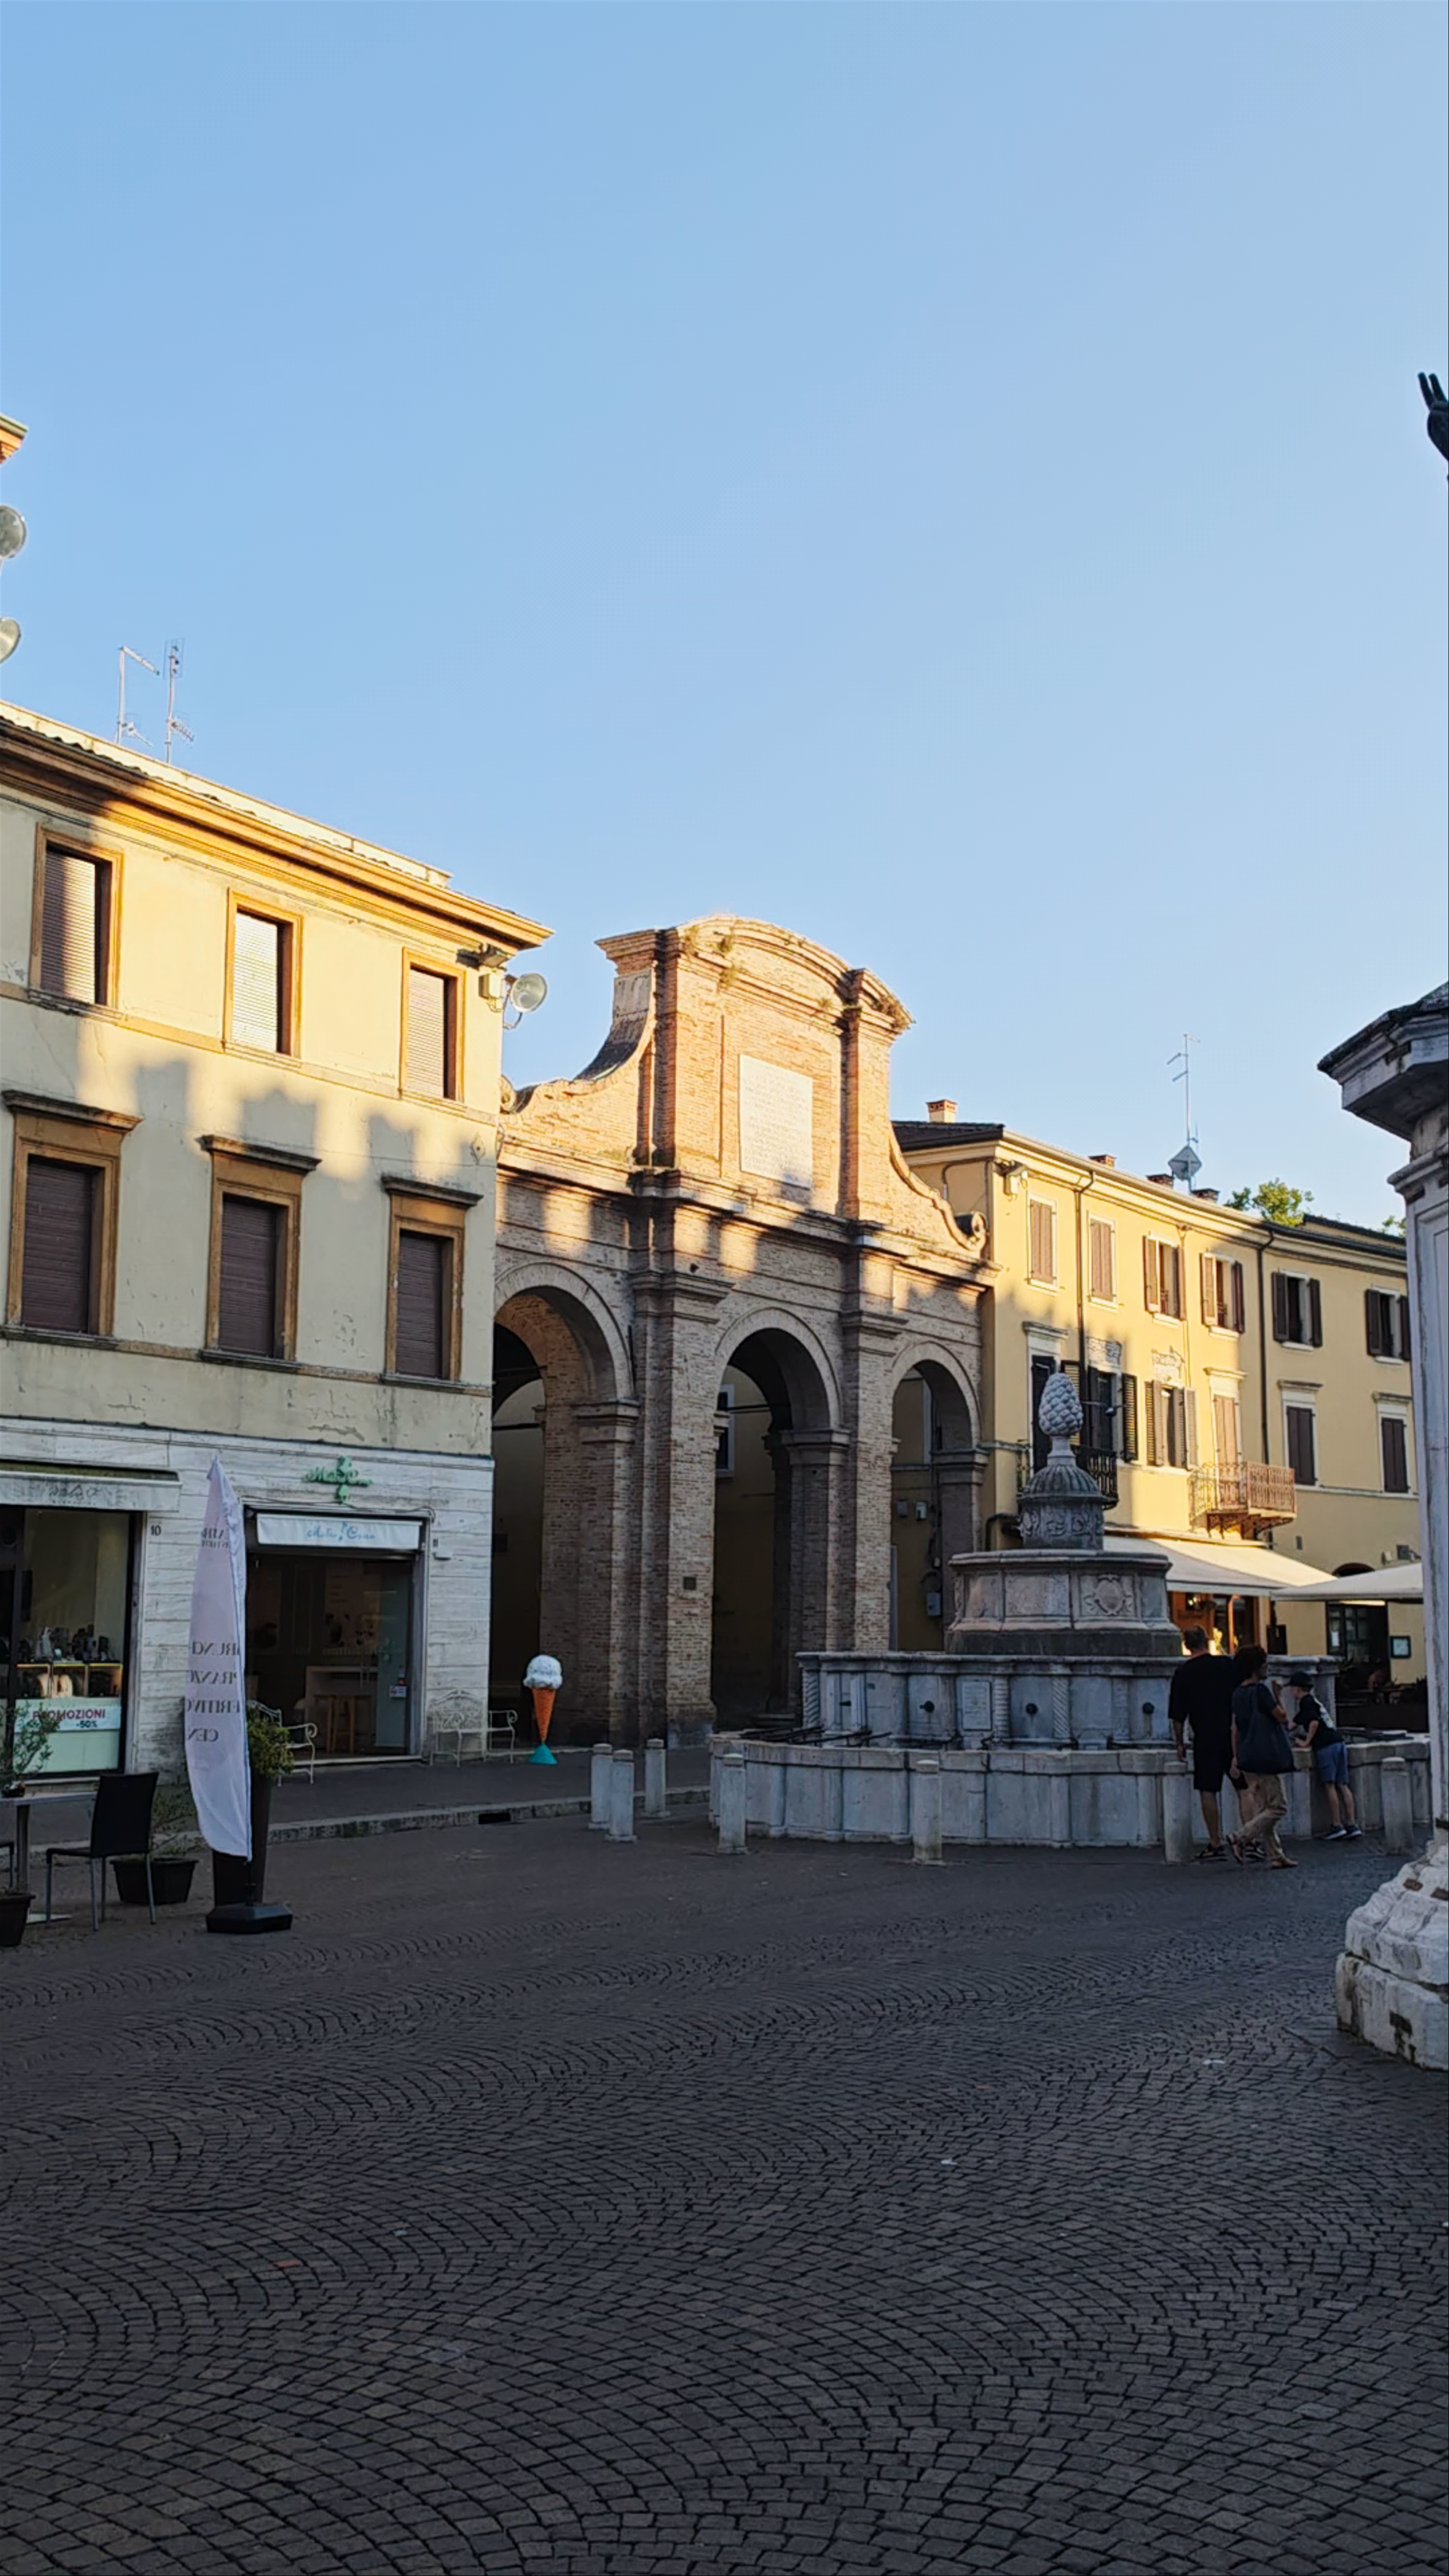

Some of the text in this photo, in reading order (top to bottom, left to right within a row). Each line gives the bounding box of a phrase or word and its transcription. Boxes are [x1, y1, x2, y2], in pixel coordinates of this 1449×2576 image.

[151, 1525, 161, 1536] 10
[33, 1709, 105, 1721] POMOZIONI
[76, 1720, 97, 1729] -50%
